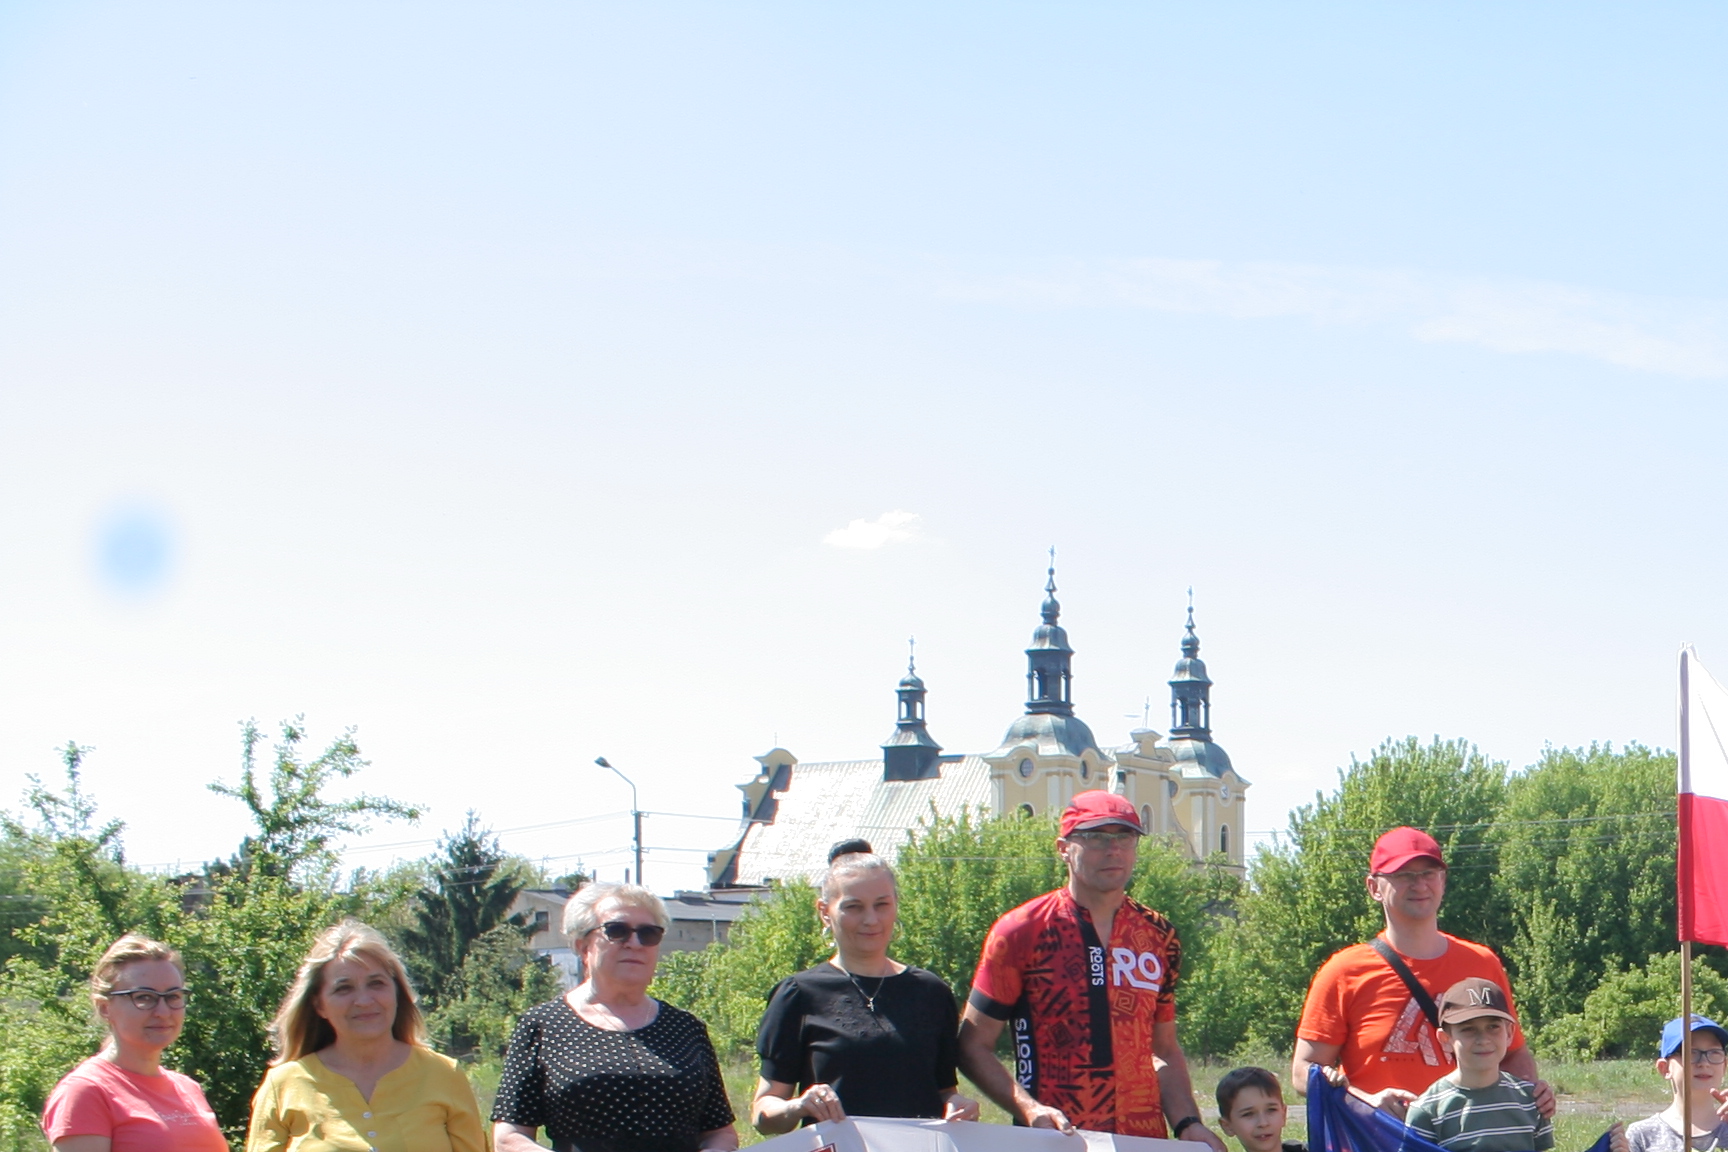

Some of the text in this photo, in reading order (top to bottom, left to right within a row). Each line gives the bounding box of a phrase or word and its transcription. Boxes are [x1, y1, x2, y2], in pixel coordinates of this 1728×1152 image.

[1087, 945, 1105, 986] ROOTS
[1466, 987, 1491, 1006] M
[1014, 1017, 1032, 1090] ROOTS
